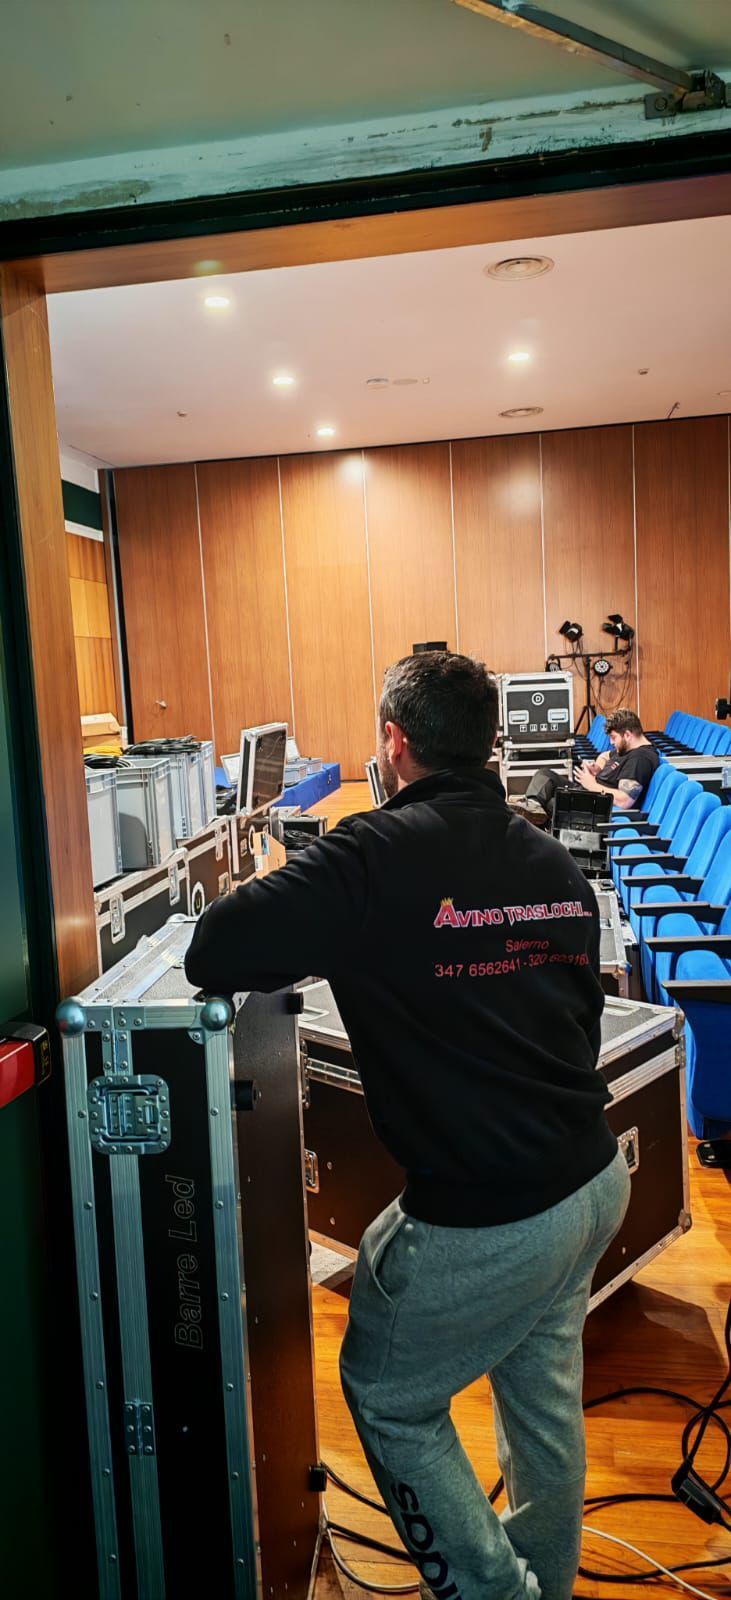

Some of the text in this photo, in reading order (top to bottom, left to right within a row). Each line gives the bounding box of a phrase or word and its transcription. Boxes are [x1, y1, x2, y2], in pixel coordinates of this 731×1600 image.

[433, 899, 584, 928] AVINO TRASLOCHI
[505, 939, 550, 953] Salerno
[434, 964, 464, 977] 347
[469, 958, 521, 977] 6562641
[528, 953, 547, 967] 320
[165, 1174, 204, 1350] Barre Led
